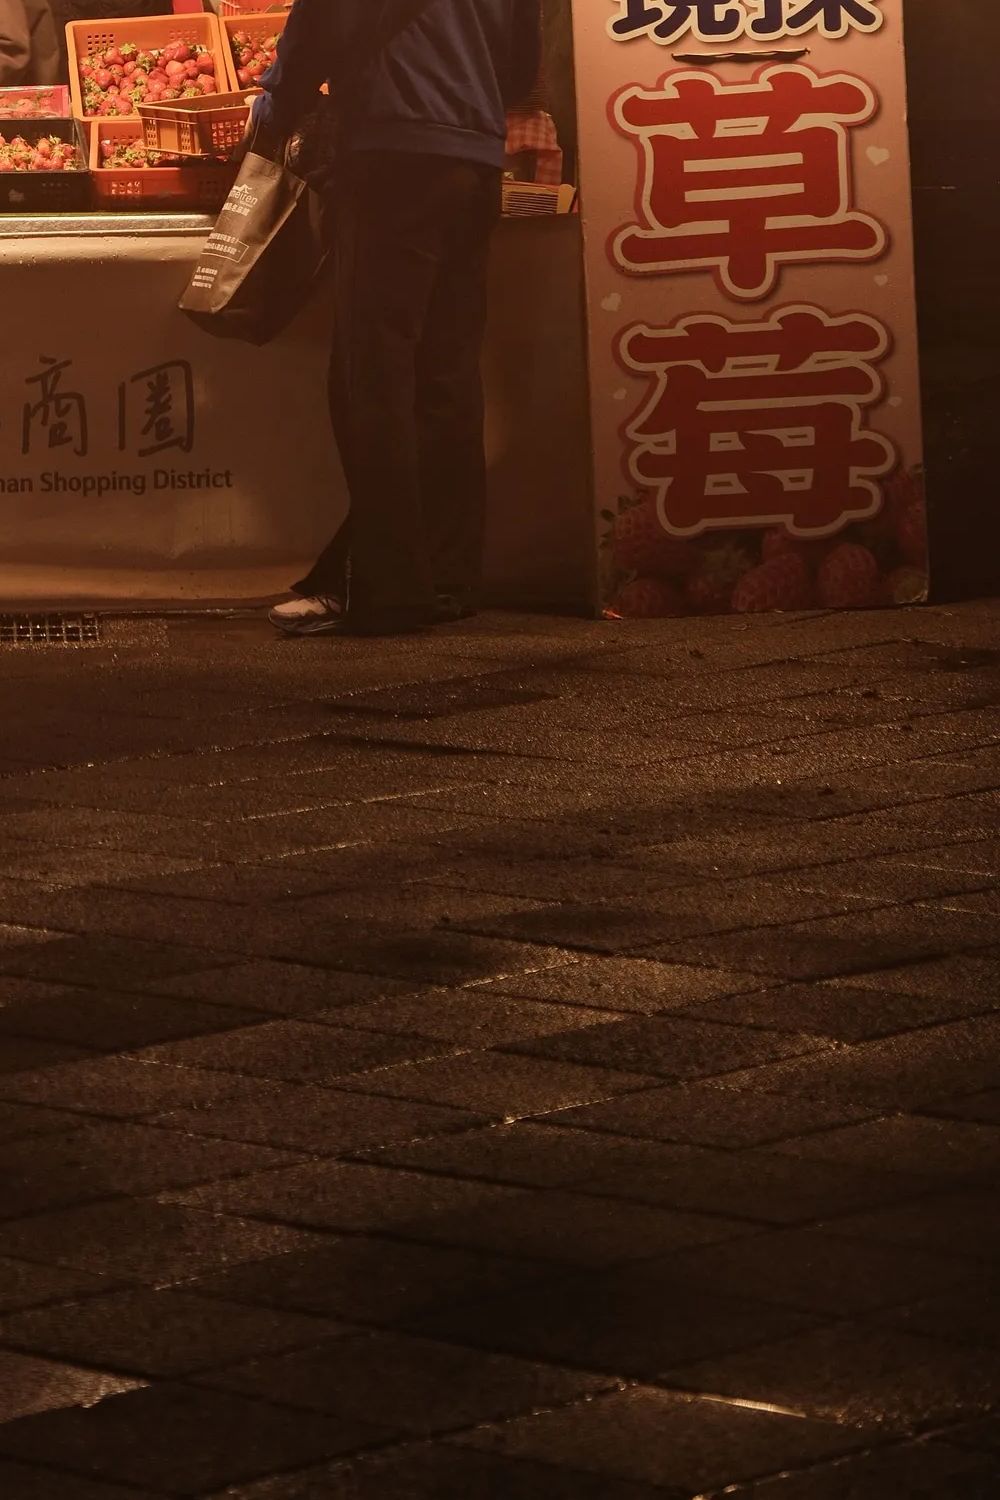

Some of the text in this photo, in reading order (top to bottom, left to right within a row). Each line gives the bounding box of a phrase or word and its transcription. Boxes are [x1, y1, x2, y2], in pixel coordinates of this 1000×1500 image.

[610, 65, 888, 534] 草莓
[40, 471, 146, 496] Shopping
[153, 467, 233, 491] District
